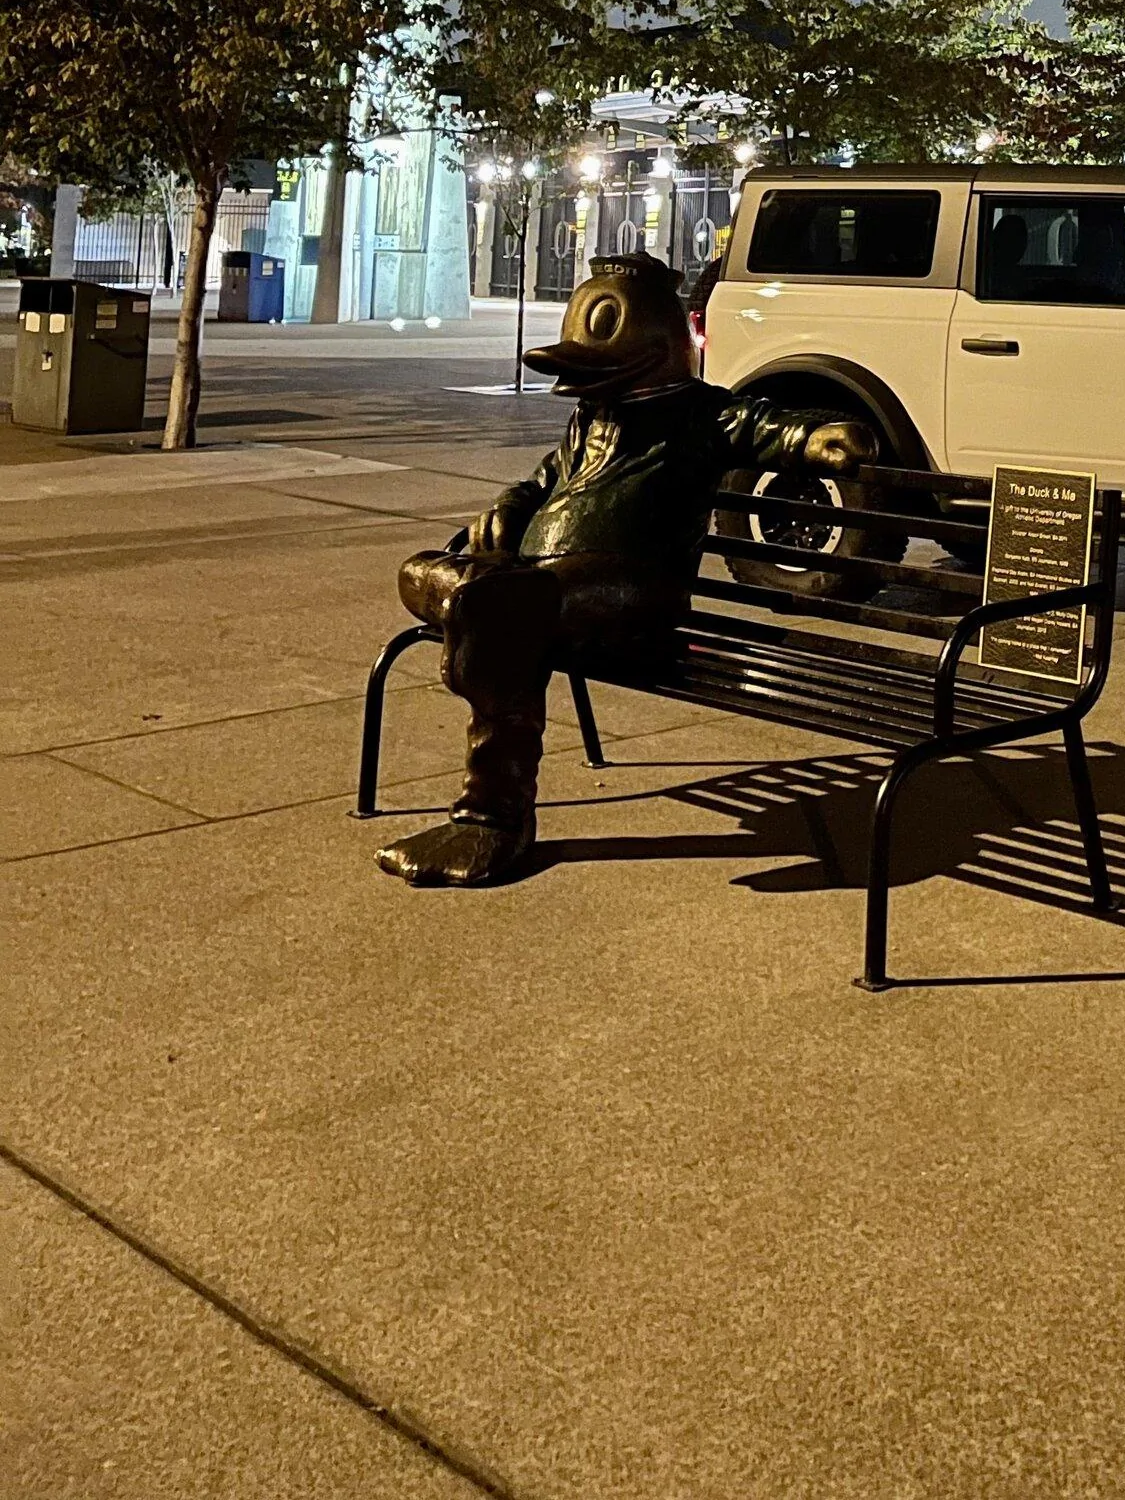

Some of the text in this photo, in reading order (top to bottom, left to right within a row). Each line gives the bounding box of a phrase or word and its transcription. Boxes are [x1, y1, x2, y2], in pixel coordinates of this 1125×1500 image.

[1009, 483, 1076, 502] The Duck & Me
[1029, 507, 1055, 518] University
[1055, 510, 1062, 518] of
[1061, 511, 1082, 521] Oregon
